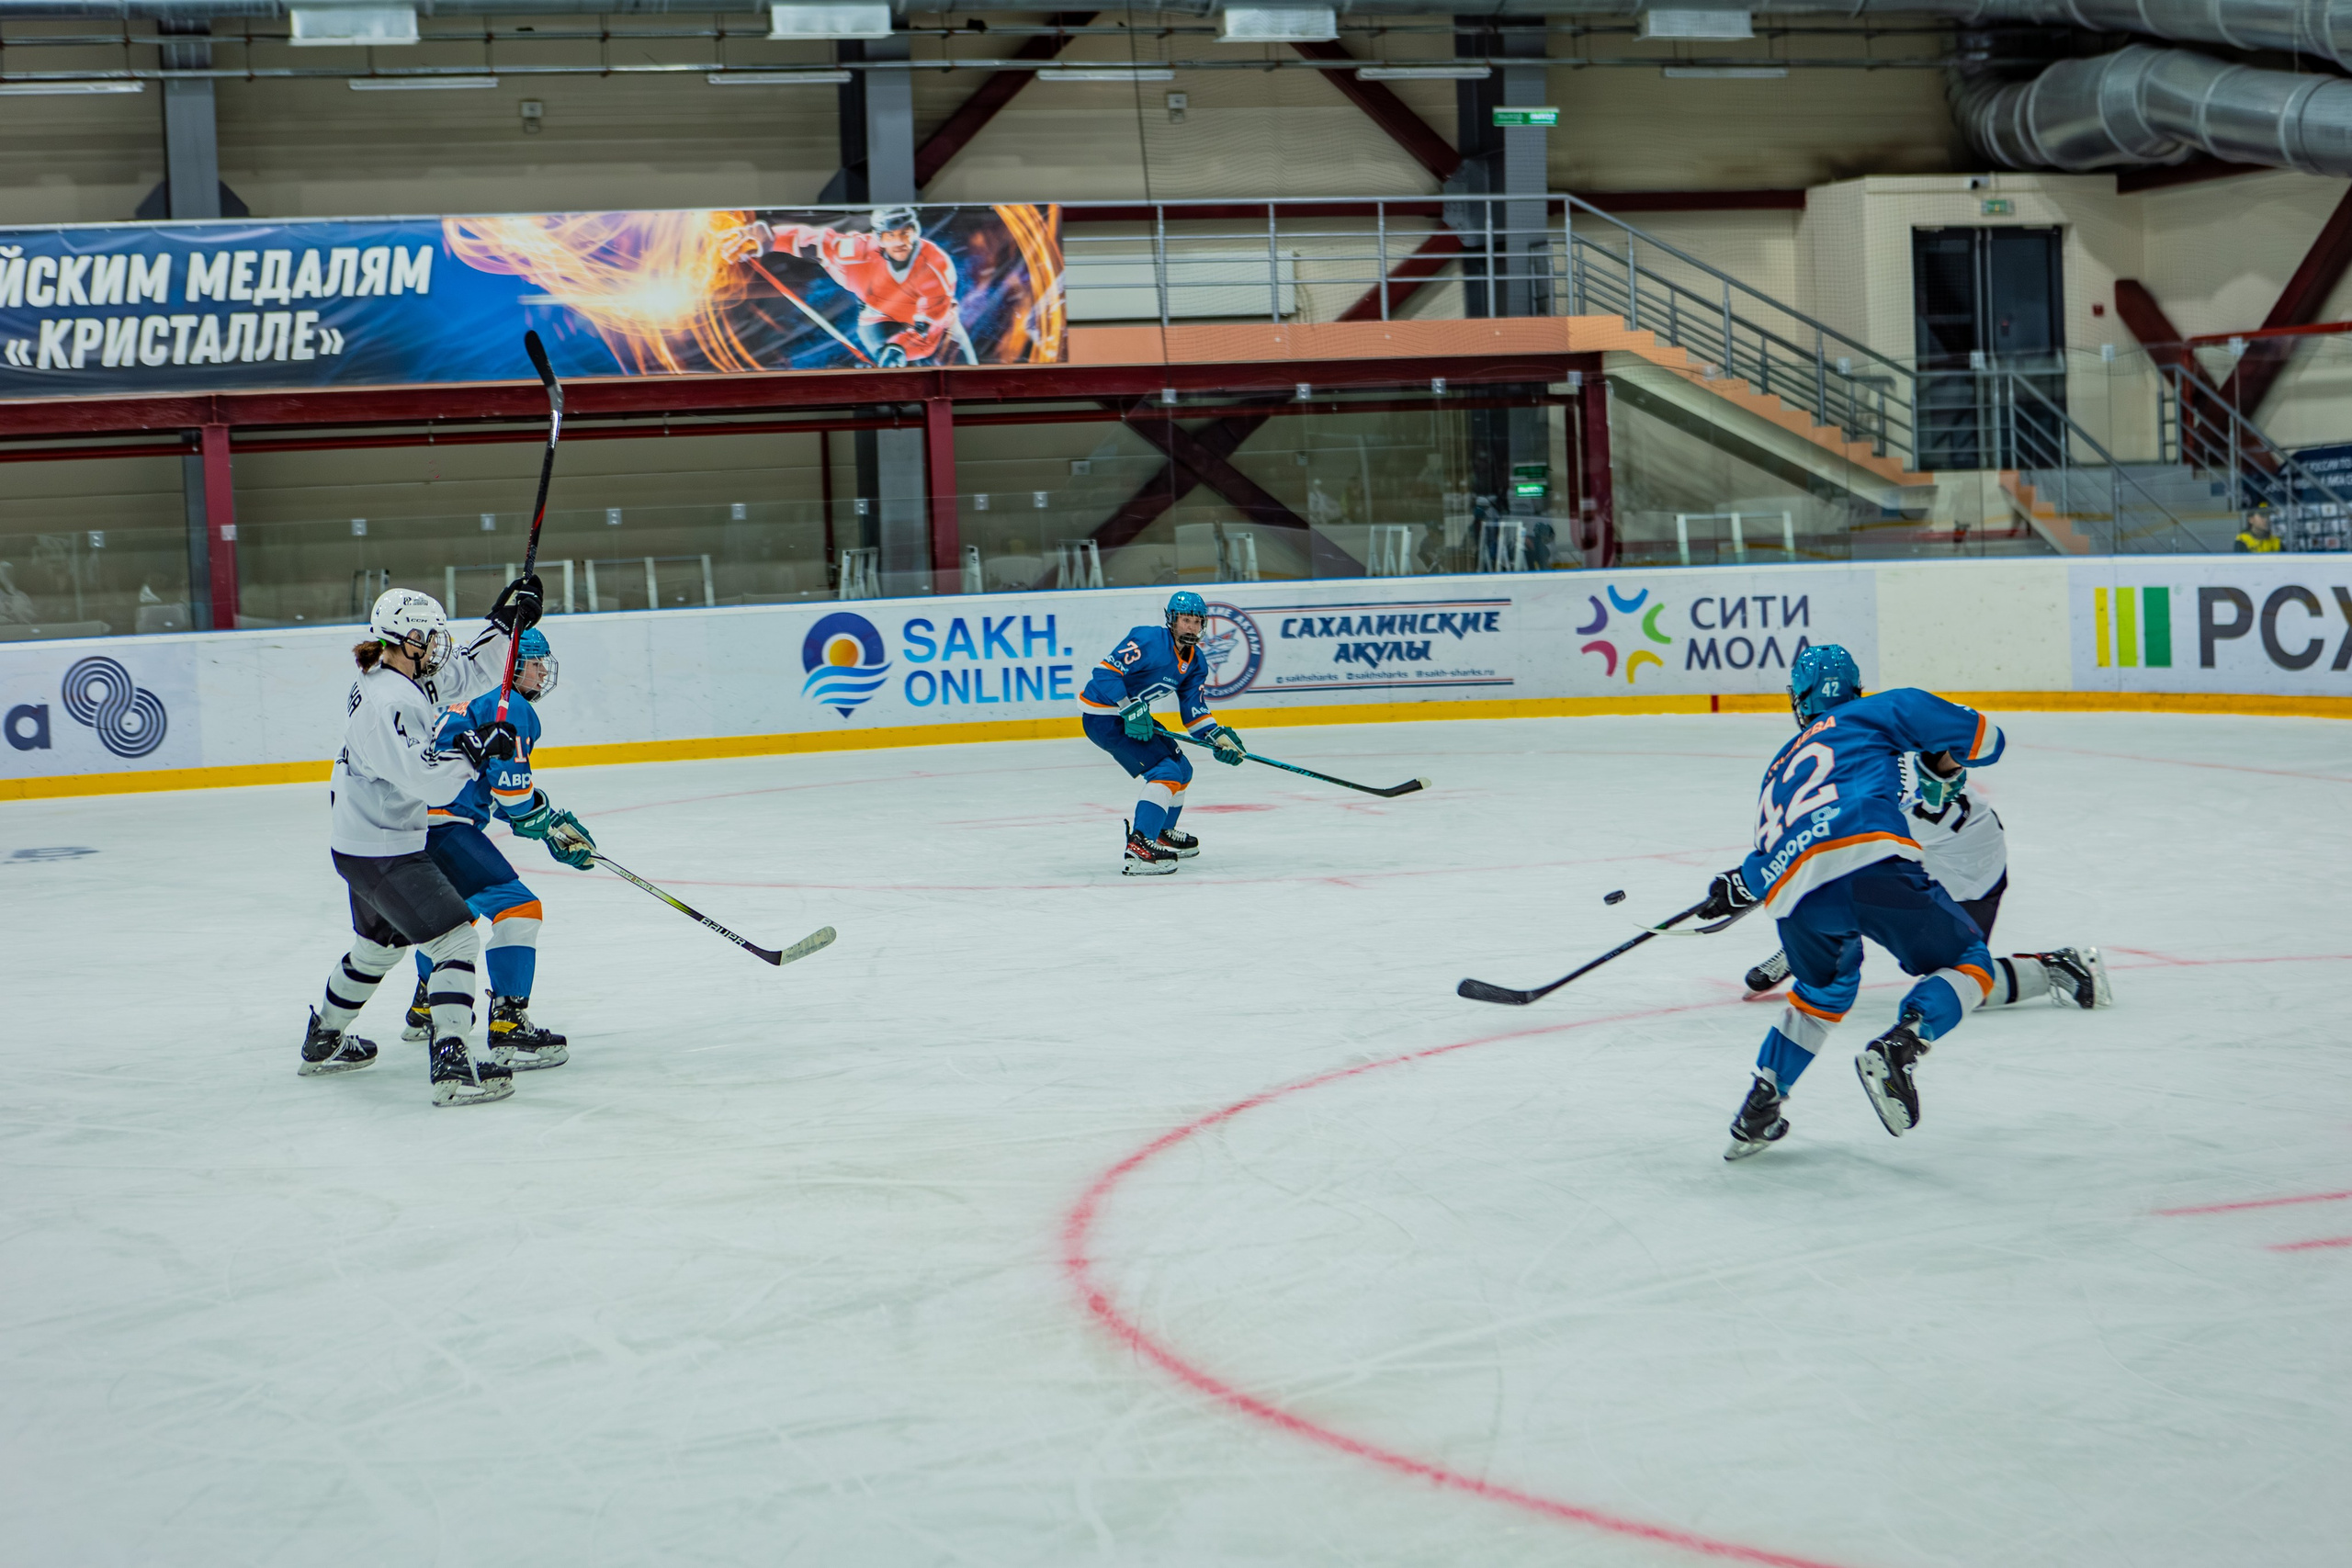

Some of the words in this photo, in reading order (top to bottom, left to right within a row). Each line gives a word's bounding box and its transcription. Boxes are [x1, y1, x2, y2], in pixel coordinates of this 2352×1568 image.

[185, 245, 434, 306] МЕДАЛЯМ
[4, 310, 346, 370] «КРИСТАЛЛЕ»
[1280, 612, 1500, 640] САХАЛИНСКИЕ
[1690, 595, 1810, 630] СИТИ
[902, 615, 1073, 663] SAKH.
[1117, 640, 1141, 665] 73
[1334, 640, 1433, 670] АКУЛЫ
[904, 664, 1076, 707] ONLINE
[1285, 672, 1339, 683] sakhsharks
[1354, 671, 1408, 680] sakhsharks
[1424, 668, 1496, 679] sakh-sharks.ru
[1822, 682, 1839, 696] 42
[1754, 741, 1839, 854] 42
[1760, 821, 1831, 889] Аврора
[699, 917, 746, 947] BAUER
